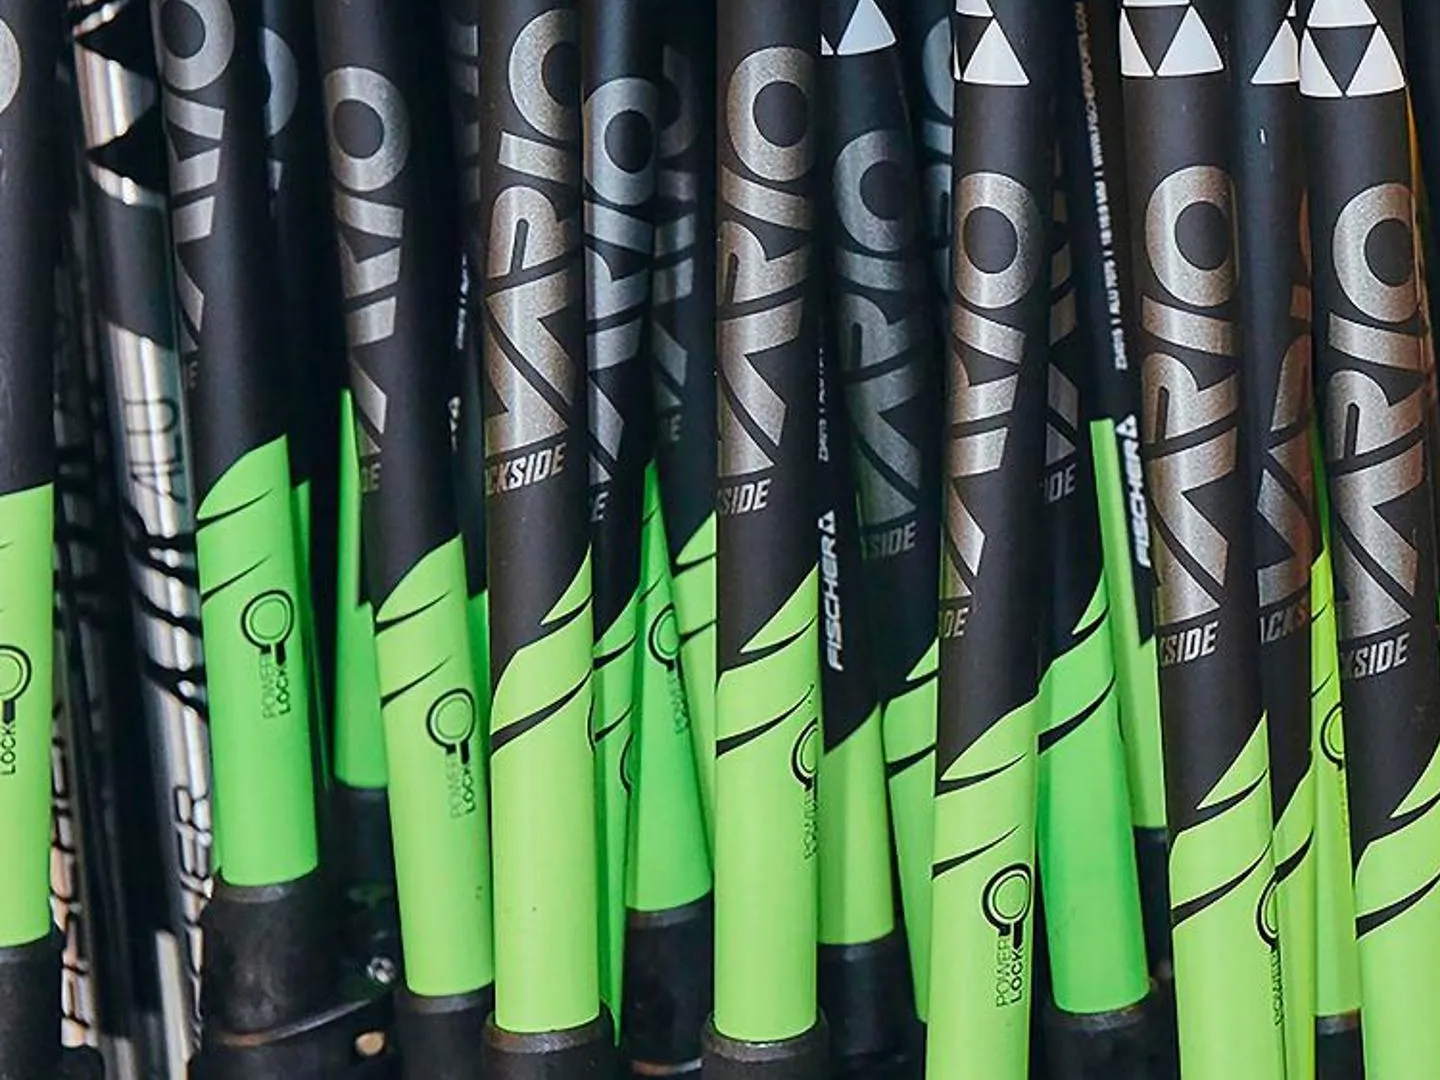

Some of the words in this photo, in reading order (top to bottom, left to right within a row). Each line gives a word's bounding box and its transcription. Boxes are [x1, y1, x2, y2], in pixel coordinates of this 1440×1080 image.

[486, 8, 581, 453] VARIO
[716, 46, 815, 479] VARIO
[833, 129, 922, 528] VARIO
[1141, 165, 1238, 625] VARIO
[125, 397, 186, 506] ALU
[1258, 190, 1312, 607] VAR
[1329, 183, 1431, 639] VARIO
[1121, 440, 1152, 569] FISCHER
[818, 532, 845, 671] FISCHER
[0, 723, 16, 776] LOCK
[276, 665, 291, 715] LOCK
[461, 764, 476, 814] LOCK
[996, 936, 1011, 1007] POWER
[1010, 947, 1024, 1004] LOCK
